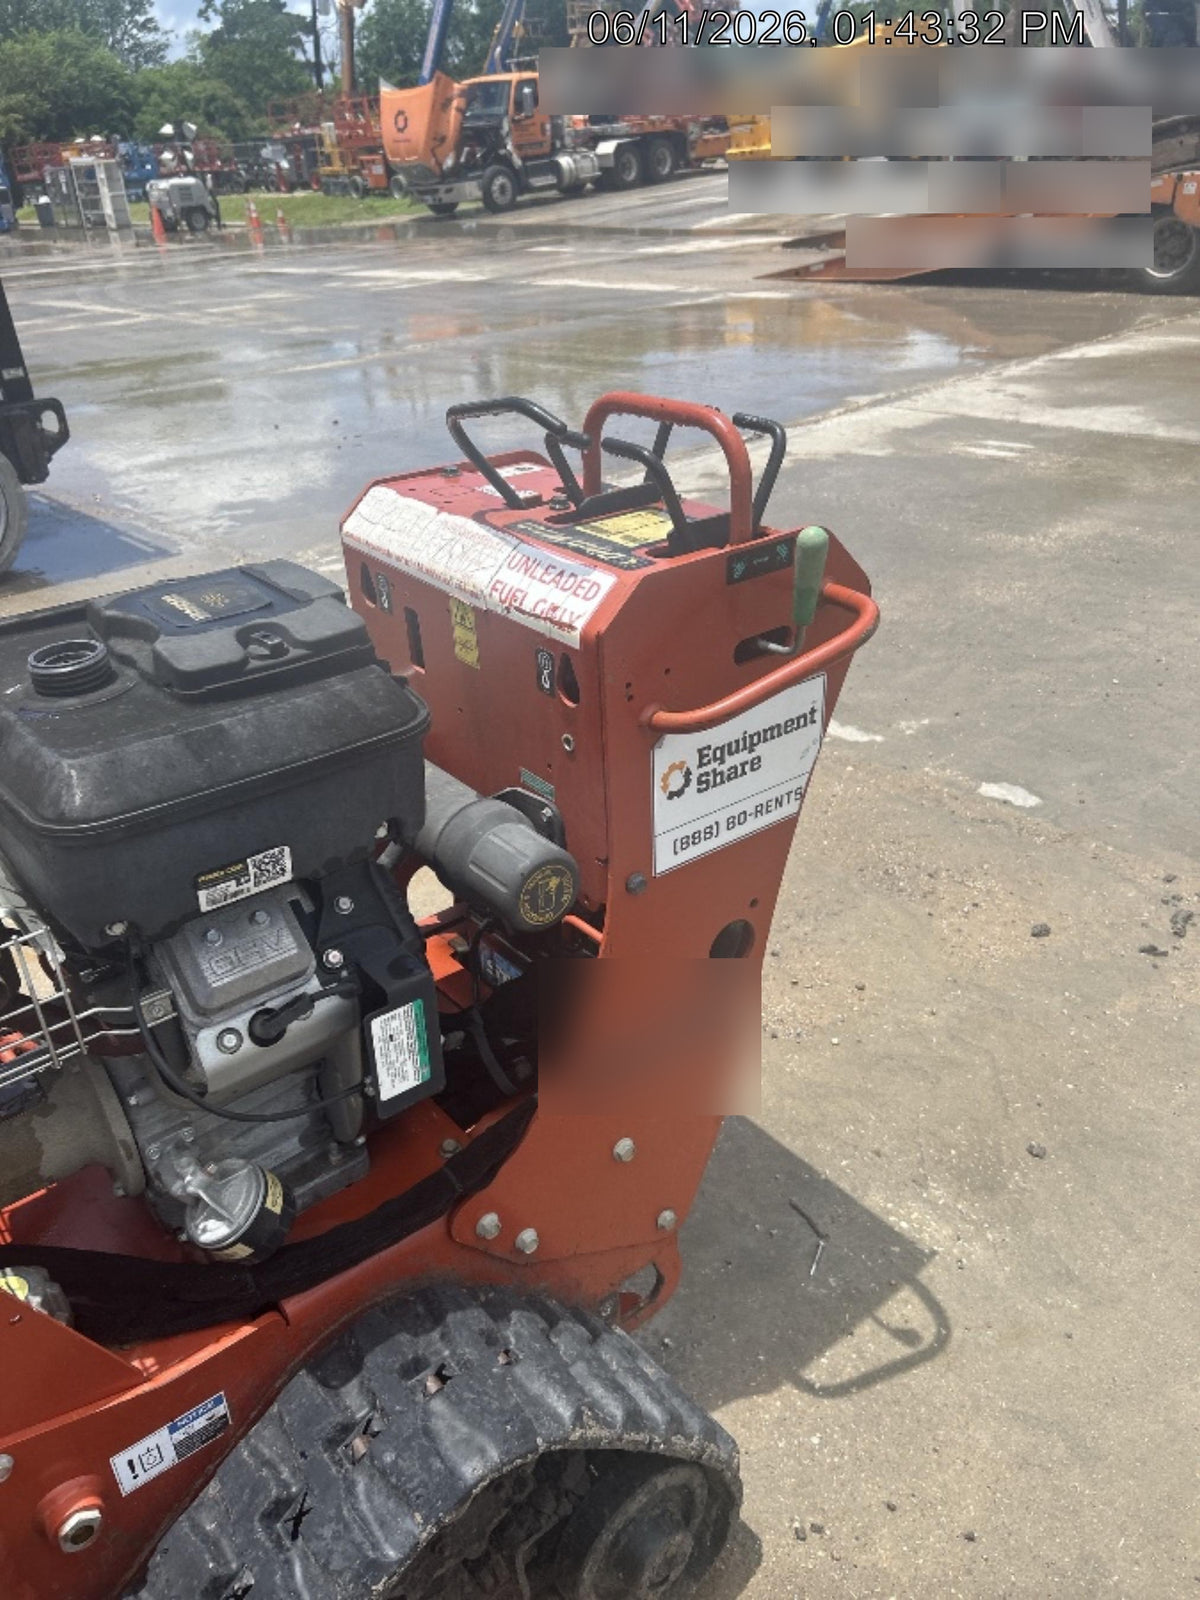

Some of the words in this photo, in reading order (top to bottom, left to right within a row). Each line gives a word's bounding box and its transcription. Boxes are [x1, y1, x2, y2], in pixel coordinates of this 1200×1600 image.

[489, 578, 529, 608] FUEL
[507, 550, 601, 602] UNLEADED
[696, 705, 818, 769] Equipment
[696, 754, 762, 793] Share
[673, 821, 720, 855] (888)
[726, 787, 803, 832] 80-RENTS
